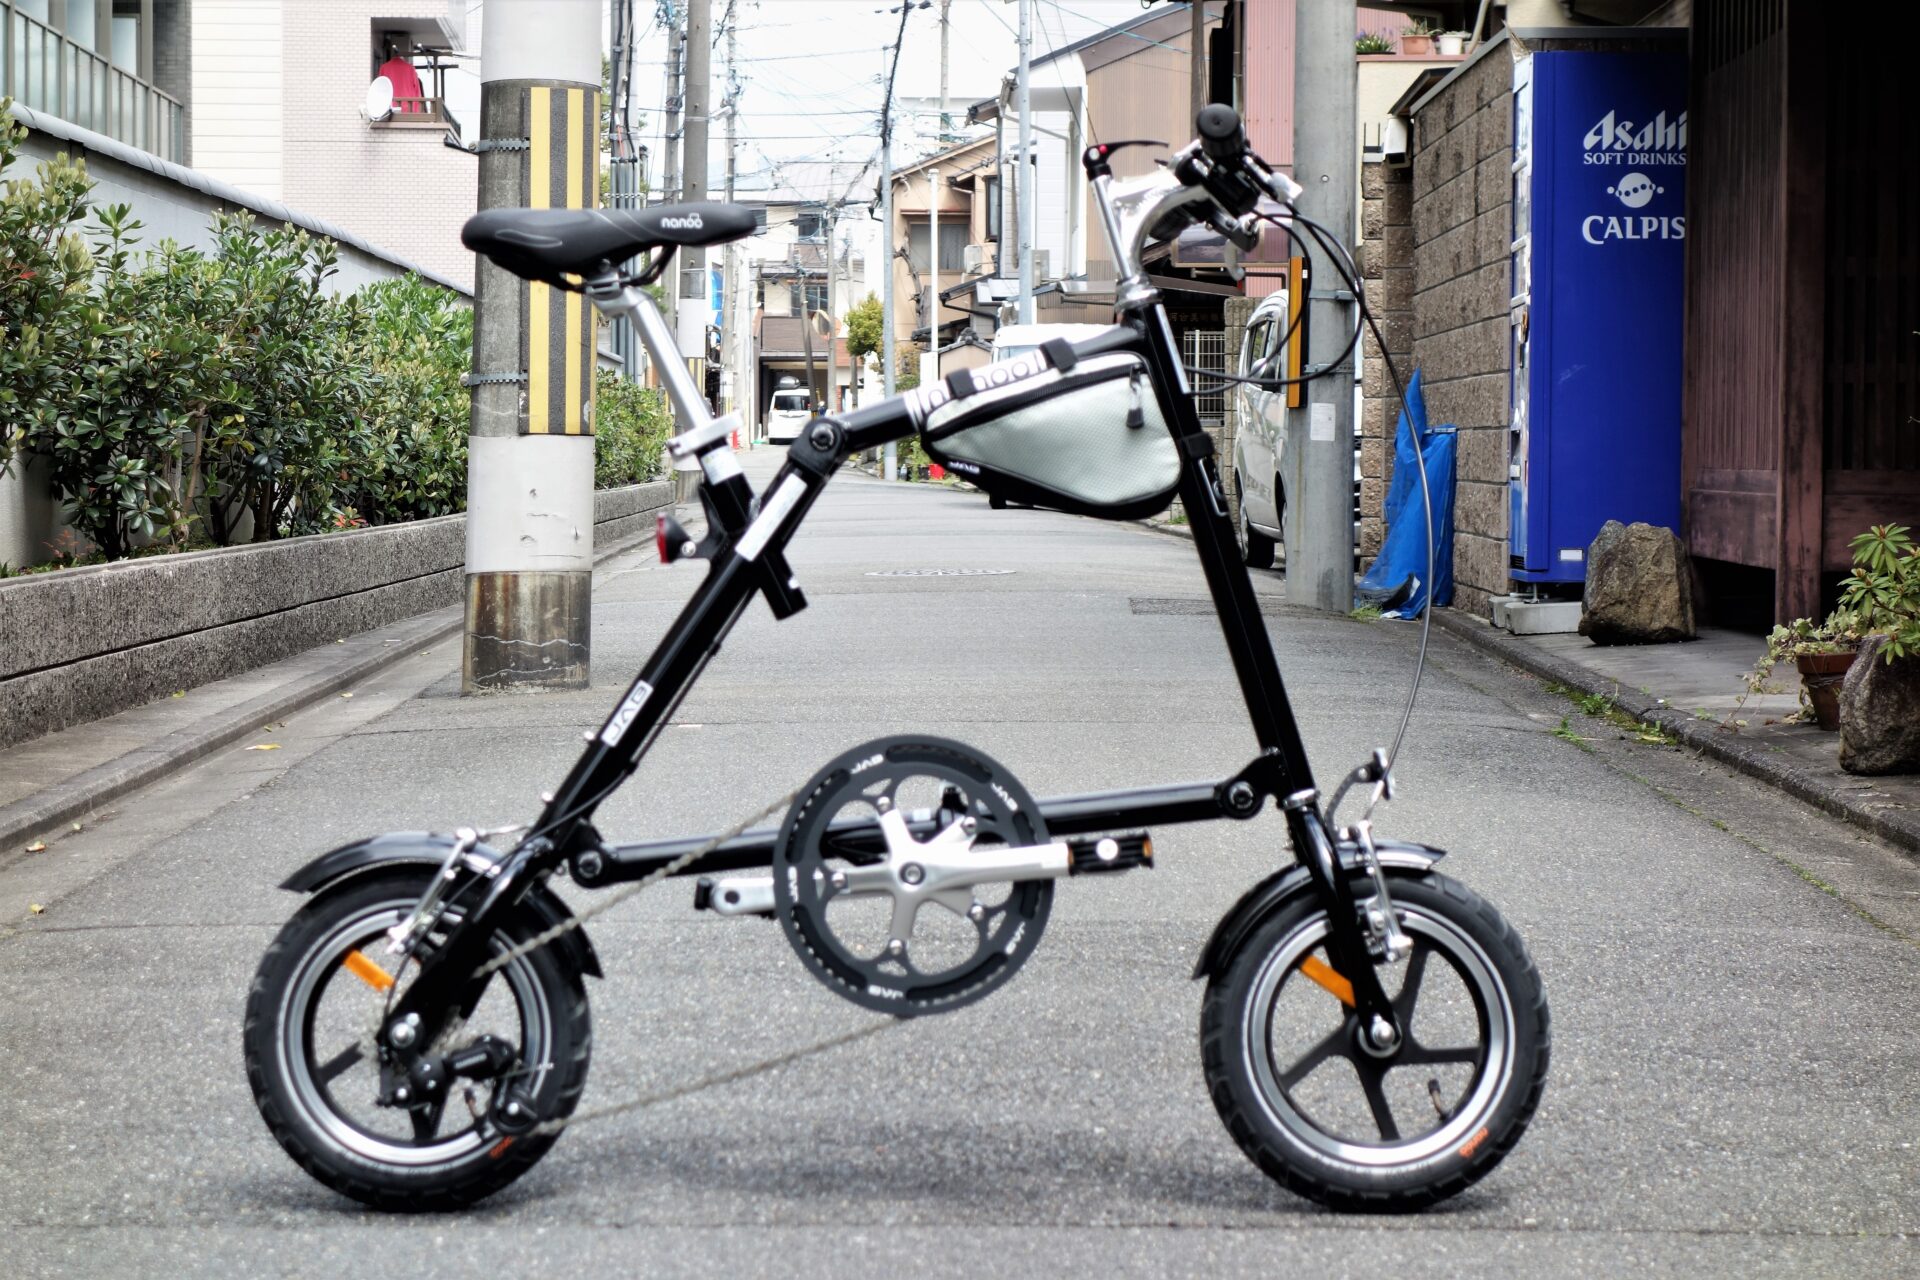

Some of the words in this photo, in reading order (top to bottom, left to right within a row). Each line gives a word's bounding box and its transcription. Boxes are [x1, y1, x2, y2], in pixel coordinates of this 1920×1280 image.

[1583, 110, 1687, 150] Asahi
[1583, 153, 1624, 165] SOFT
[1628, 153, 1687, 165] DRINKS
[661, 214, 703, 229] nanoo
[1582, 215, 1686, 245] CALPIS
[609, 684, 648, 742] JAB
[851, 754, 884, 774] JAB
